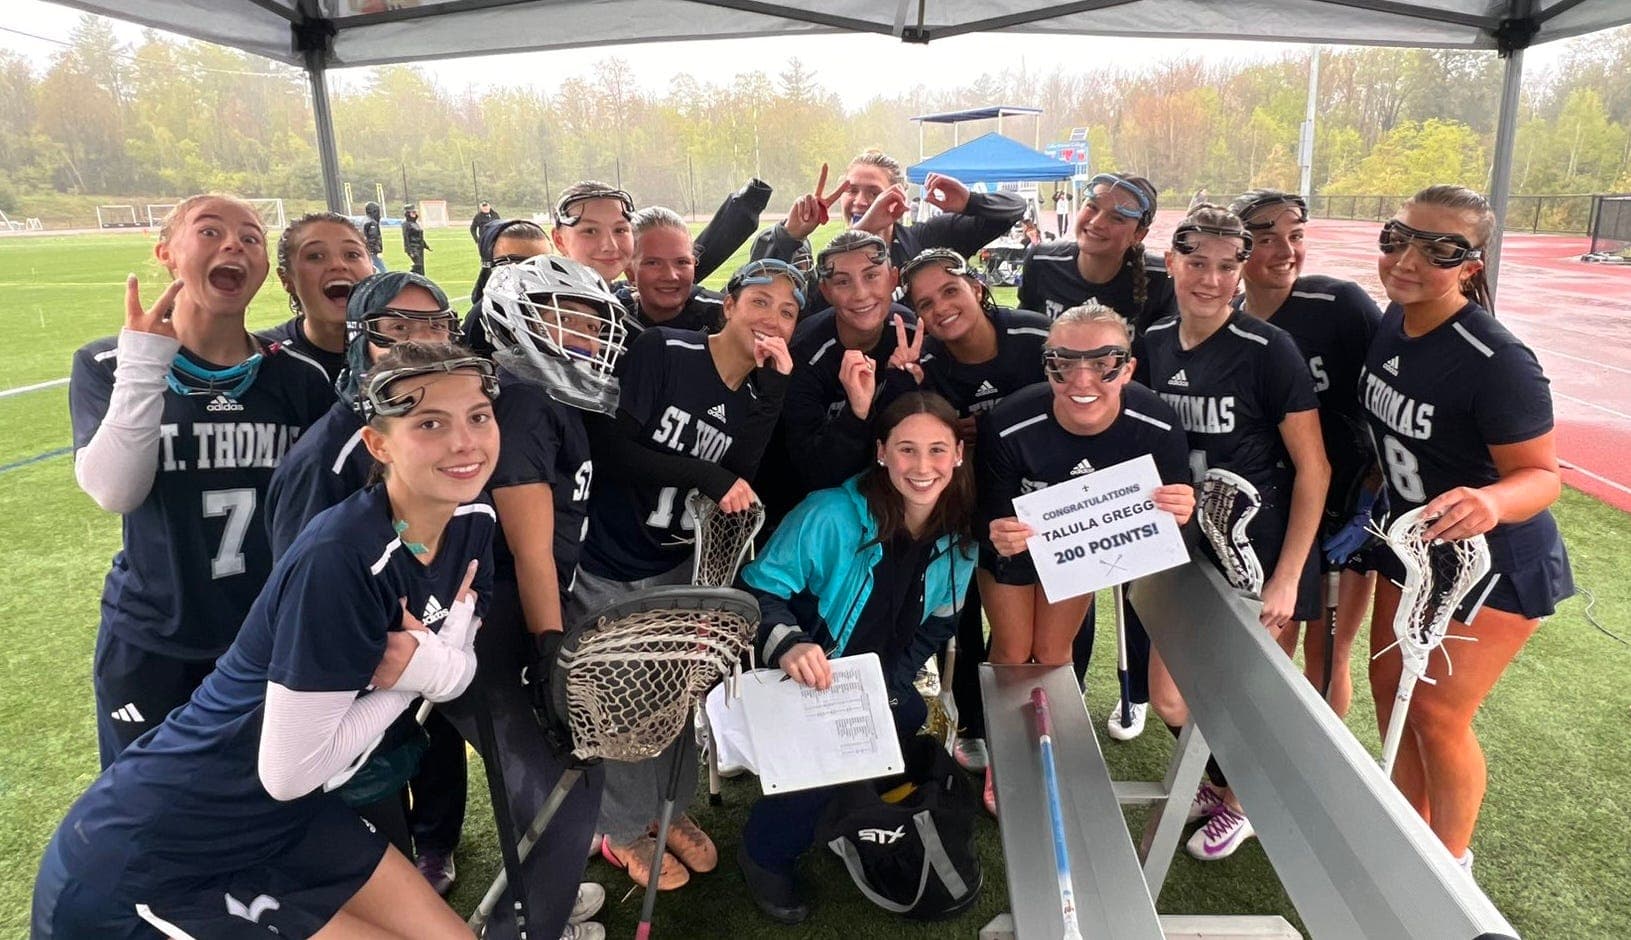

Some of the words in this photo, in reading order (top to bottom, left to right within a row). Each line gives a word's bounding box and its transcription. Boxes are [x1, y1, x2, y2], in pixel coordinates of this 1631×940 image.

[206, 403, 244, 412] adidas
[652, 405, 691, 452] ST.
[1365, 372, 1435, 440] THOMAS
[160, 423, 187, 471] T.
[1383, 434, 1427, 503] 8
[1042, 483, 1141, 521] CONGRATULATIONS
[1042, 518, 1099, 543] TALULA
[1102, 499, 1155, 524] GREGG
[202, 488, 257, 580] 7
[1054, 545, 1085, 565] 200
[1088, 523, 1160, 554] POINTS!
[858, 825, 906, 844] STX
